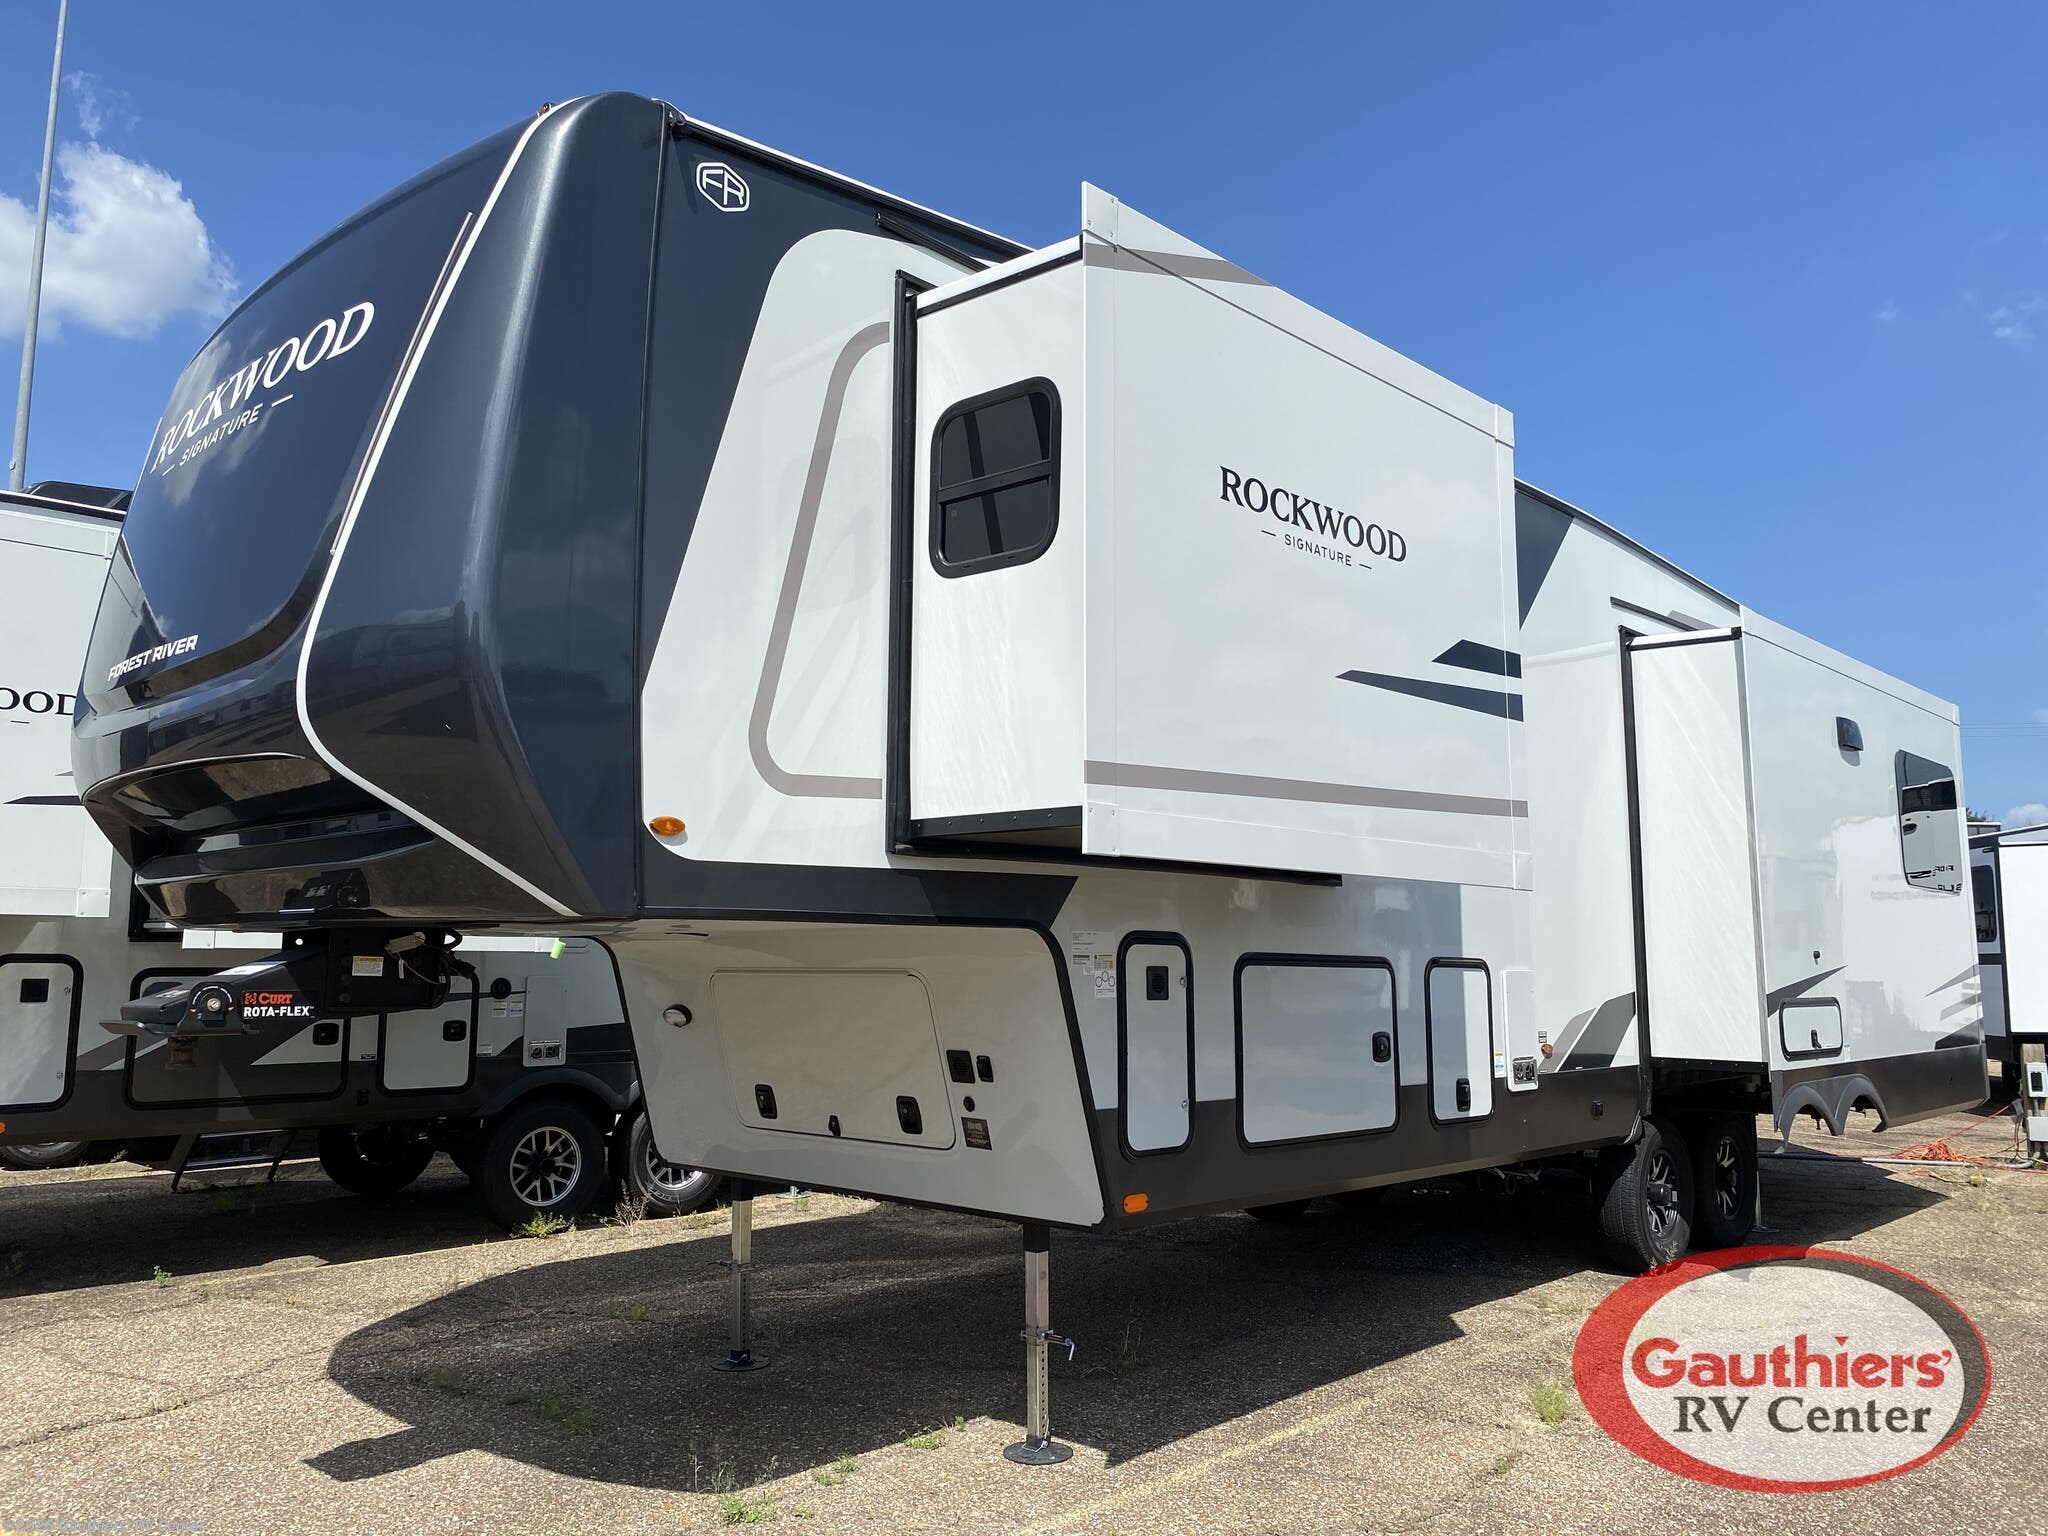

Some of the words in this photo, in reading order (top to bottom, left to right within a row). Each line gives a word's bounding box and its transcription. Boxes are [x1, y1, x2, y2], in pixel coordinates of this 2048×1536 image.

[150, 301, 375, 475] ROCKWOOD
[179, 403, 264, 466] SIGNATURE
[1219, 465, 1407, 562] ROCKWOOD
[1284, 533, 1352, 567] SIGNATURE
[107, 649, 152, 682] FOREST
[151, 634, 199, 662] RIVER
[243, 1005, 310, 1017] ROTA-FLEX
